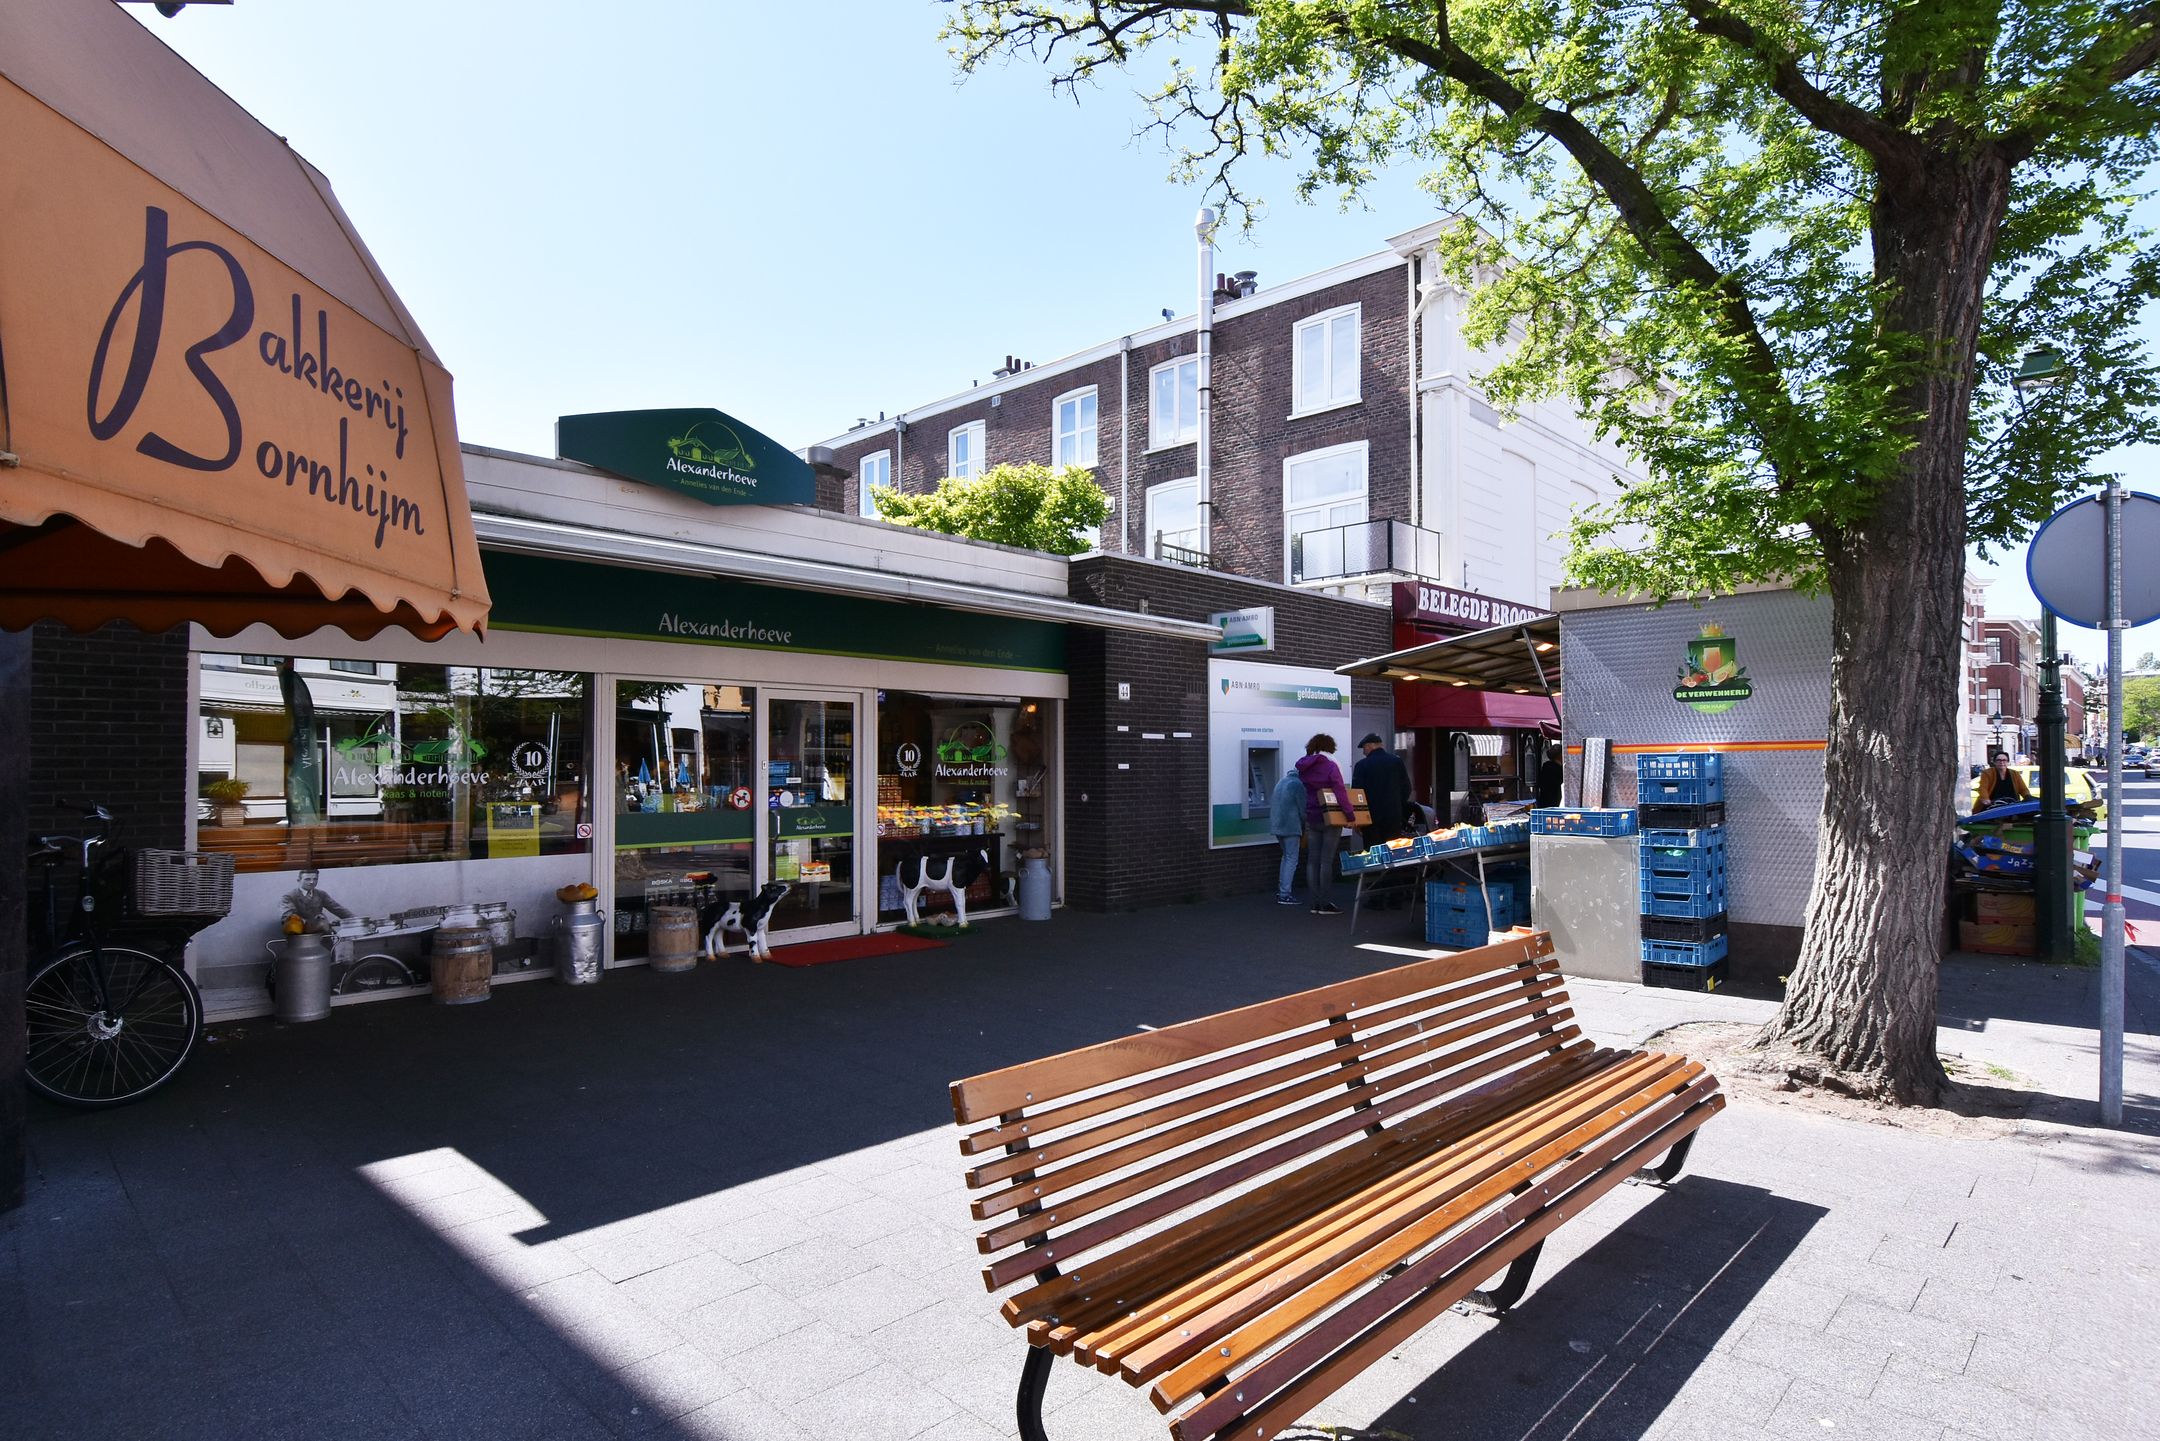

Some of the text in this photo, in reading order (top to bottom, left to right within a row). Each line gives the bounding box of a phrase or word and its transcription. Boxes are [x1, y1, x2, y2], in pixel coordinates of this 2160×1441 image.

[666, 457, 758, 488] Alexanderhoeve
[1418, 586, 1490, 623] BELEGDE
[658, 612, 792, 644] Alexanderhoeve
[1120, 686, 1129, 697] 44
[1297, 687, 1339, 702] geldautomaat
[1676, 688, 1749, 699] DE VERWENNERIJ
[524, 750, 542, 767] 10
[904, 749, 915, 762] 10
[333, 765, 490, 786] Alexanderhoeve
[935, 763, 1009, 777] Alexanderhoeve
[516, 778, 547, 788] JAAR
[383, 787, 448, 799] kaas & noten
